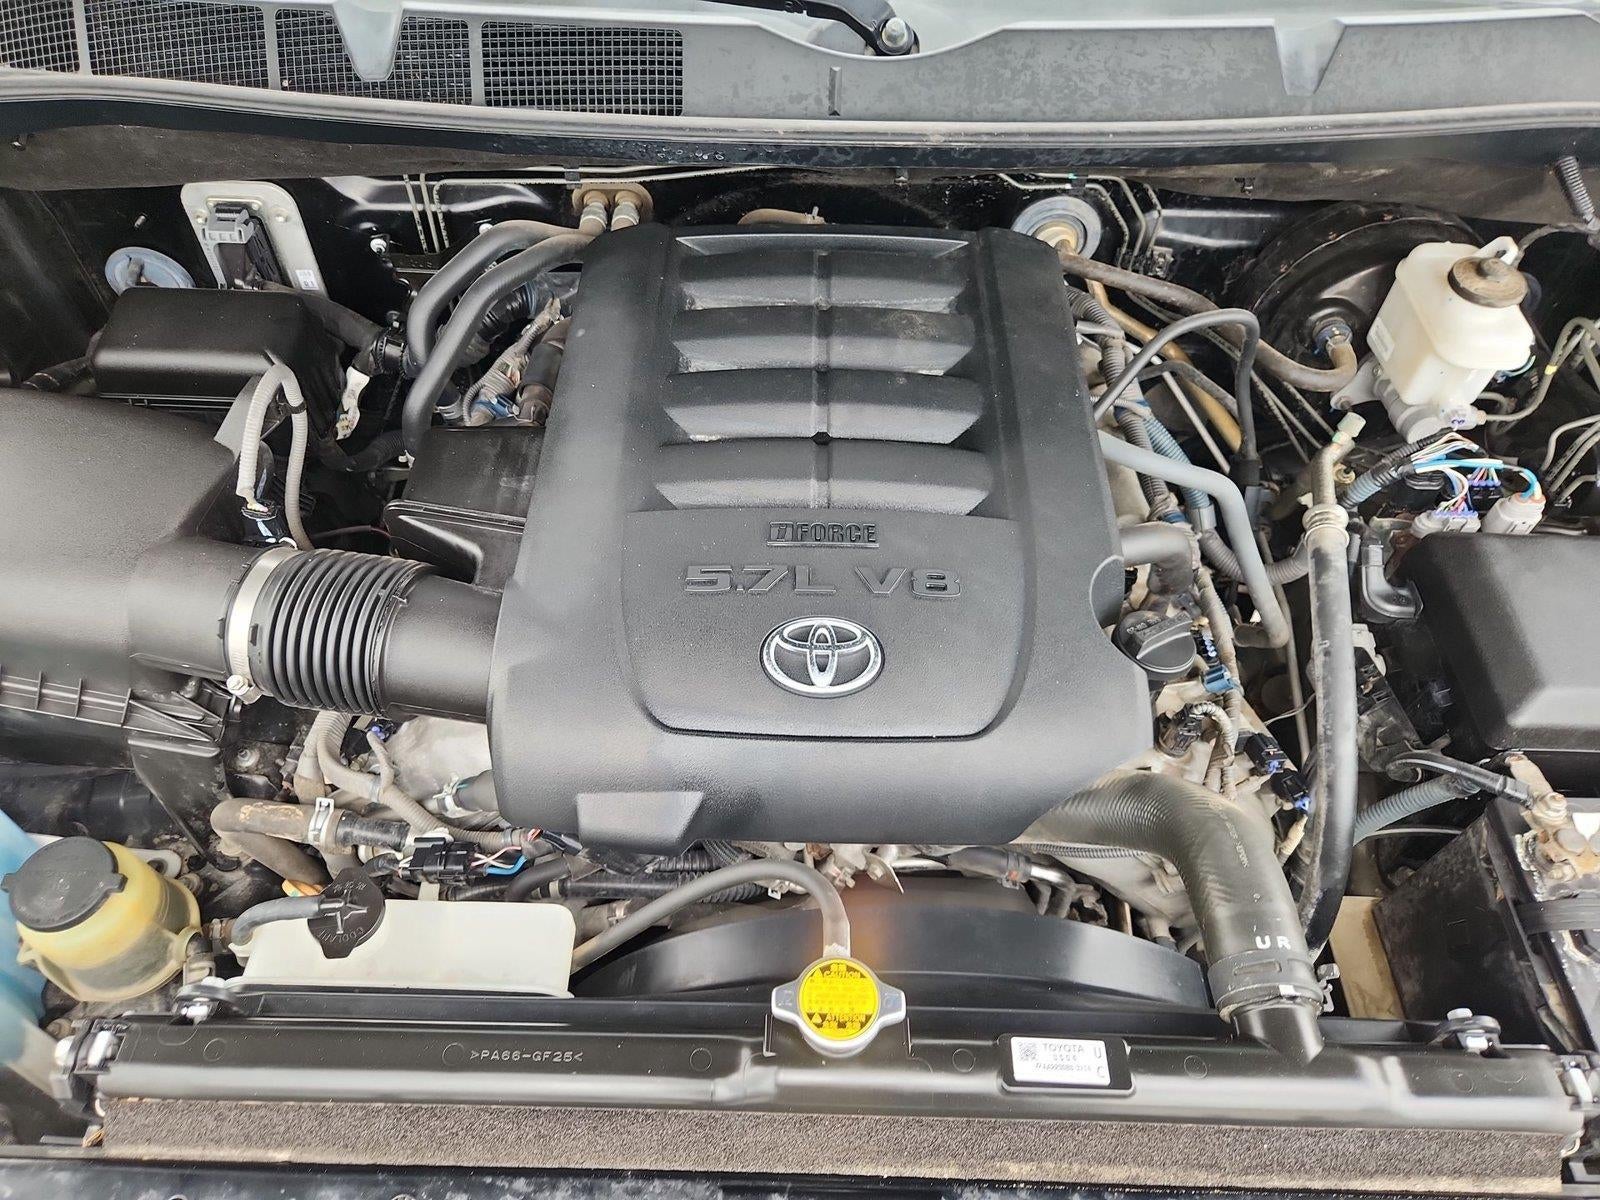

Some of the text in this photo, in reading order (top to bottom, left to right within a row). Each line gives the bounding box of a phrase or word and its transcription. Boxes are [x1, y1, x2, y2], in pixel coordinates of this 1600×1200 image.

[684, 564, 962, 597] 5.7L V8
[1042, 1042, 1084, 1053] TOYOTA
